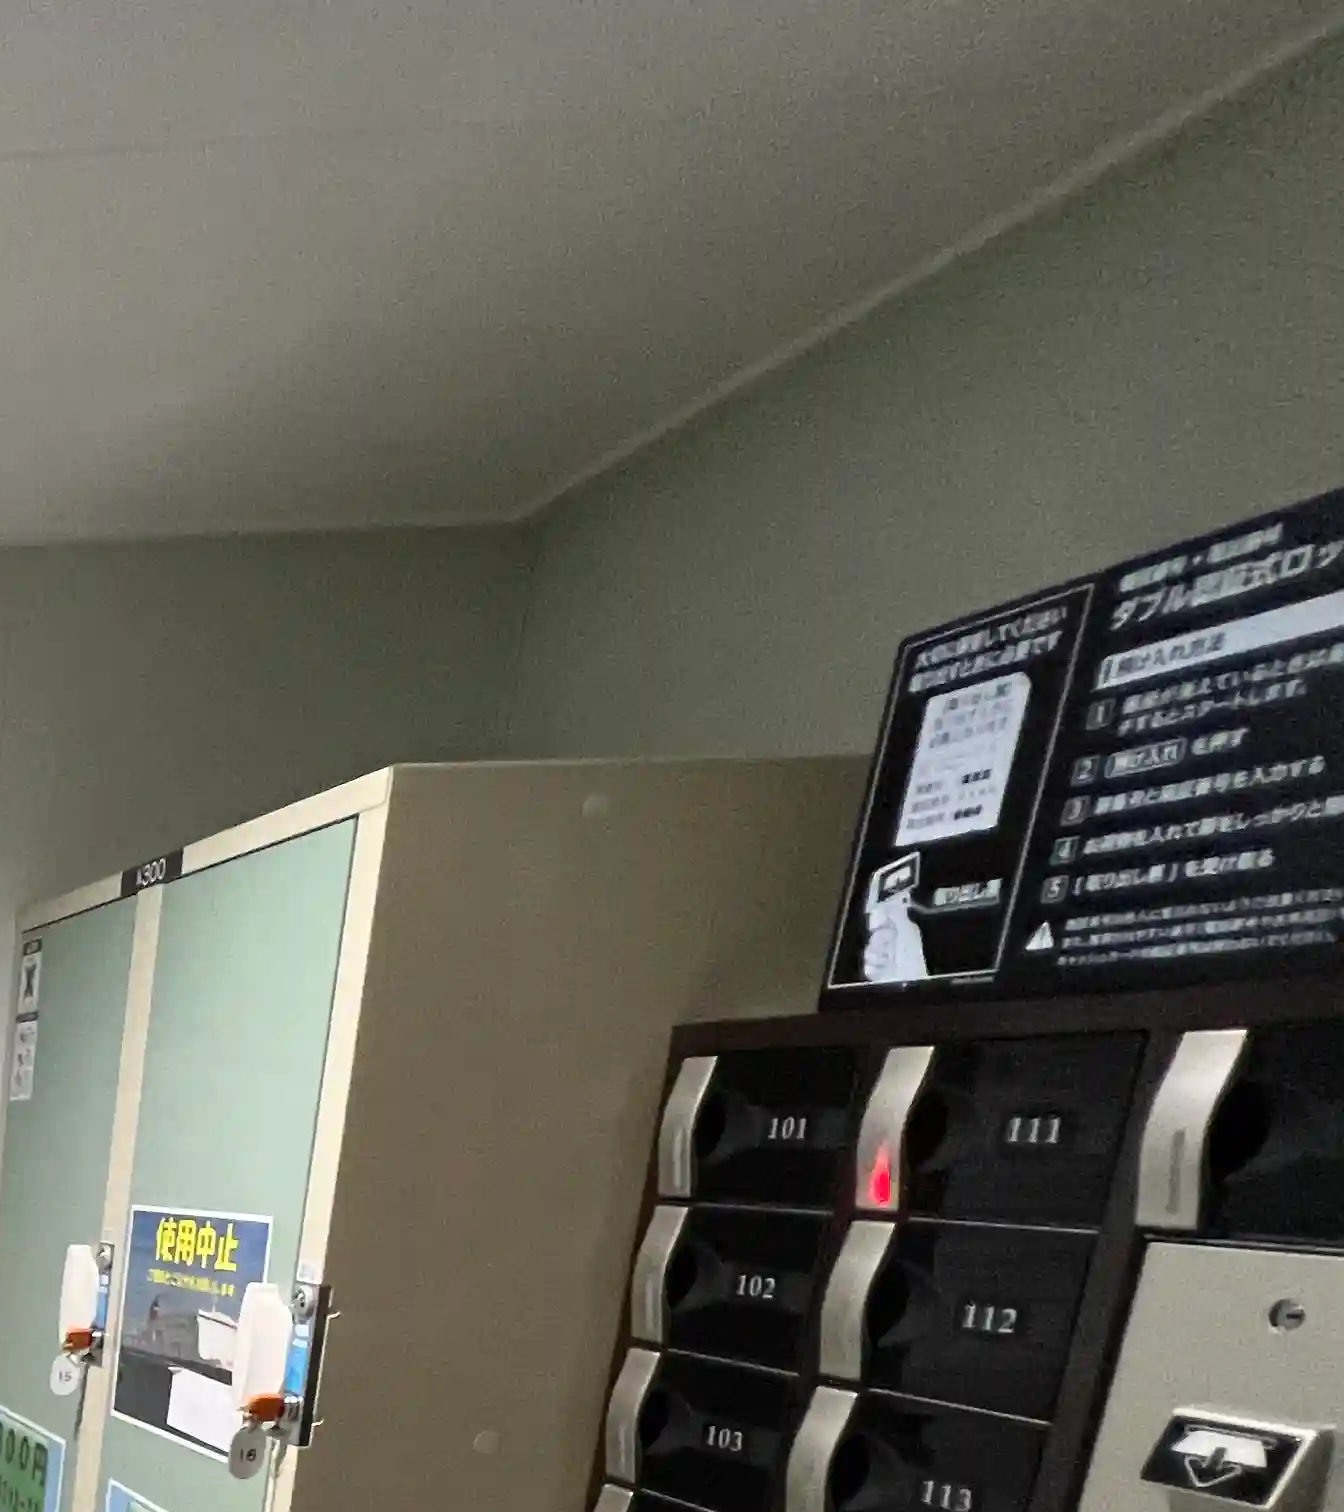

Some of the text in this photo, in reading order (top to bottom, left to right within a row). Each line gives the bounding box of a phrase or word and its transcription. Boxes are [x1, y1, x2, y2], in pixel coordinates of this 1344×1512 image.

[766, 1115, 809, 1141] 101
[1007, 1115, 1063, 1145] 111
[155, 1217, 240, 1273] 使用中止
[734, 1272, 777, 1300] 102
[961, 1302, 1018, 1334] 112
[57, 1371, 73, 1382] 15
[705, 1424, 745, 1453] 103
